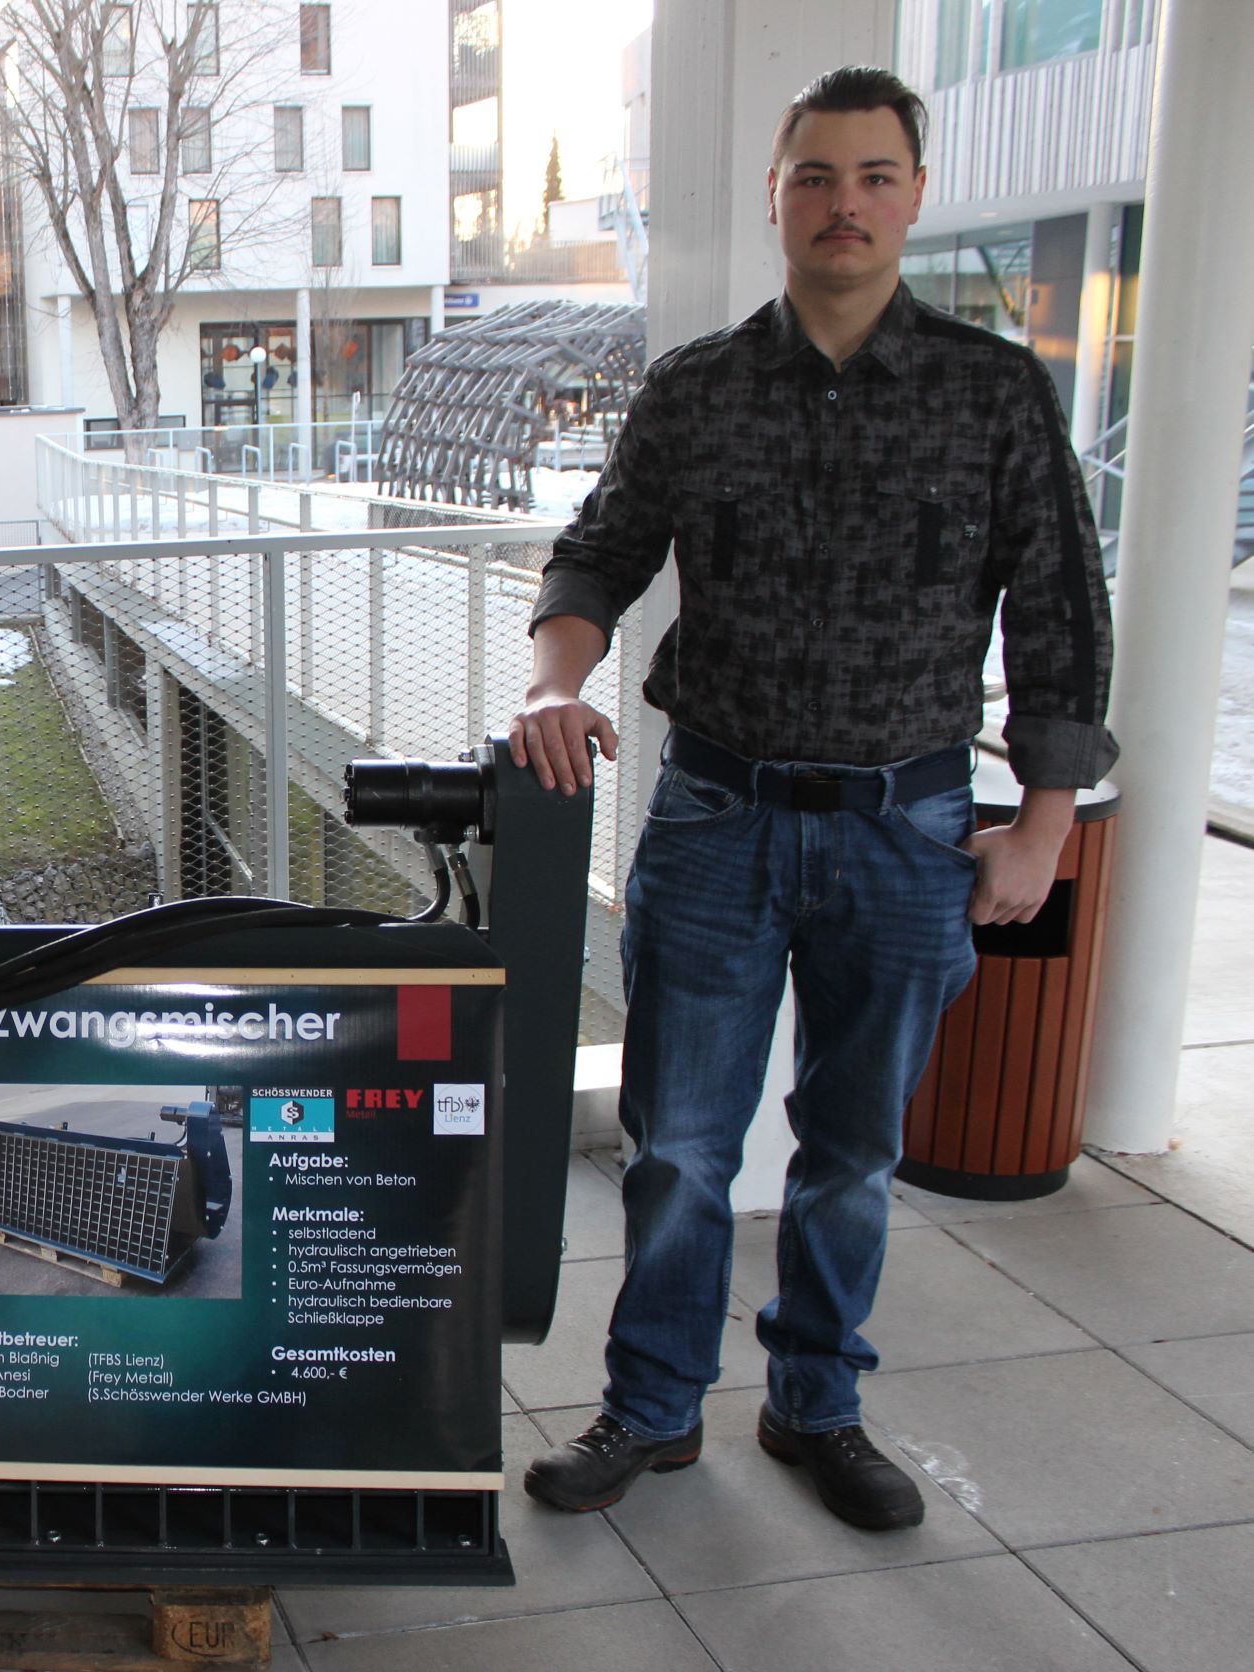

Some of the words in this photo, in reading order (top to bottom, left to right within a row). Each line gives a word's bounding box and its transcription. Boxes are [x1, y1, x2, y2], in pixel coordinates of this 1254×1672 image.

[251, 1087, 333, 1098] SCHÖSSWENDER
[346, 1089, 424, 1109] FREY
[444, 1114, 471, 1123] Lienz
[268, 1153, 349, 1170] Aufgabe:
[285, 1173, 343, 1186] Mischen
[346, 1177, 372, 1186] von
[376, 1174, 416, 1186] Beton
[272, 1207, 365, 1222] Merkmale:
[288, 1227, 376, 1240] selbstladend
[288, 1244, 366, 1259] hydraulisch
[369, 1245, 456, 1260] angetrieben
[330, 1262, 462, 1277] Fassungsvermögen
[288, 1278, 396, 1291] Euro-Aufnahme
[288, 1295, 366, 1309] hydraulisch
[369, 1296, 453, 1309] bedienbare
[287, 1312, 385, 1327] Schließklappe
[9, 1352, 60, 1367] Blaßnig
[88, 1353, 121, 1368] (TFBS
[125, 1353, 164, 1369] Lienz)
[271, 1346, 396, 1362] Gesamtkosten
[88, 1370, 122, 1385] (Frey
[125, 1371, 173, 1387] Metall)
[338, 1368, 348, 1379] €
[88, 1387, 205, 1403] (S.Schösswender
[208, 1390, 253, 1403] Werke
[257, 1391, 307, 1407] GMBH)
